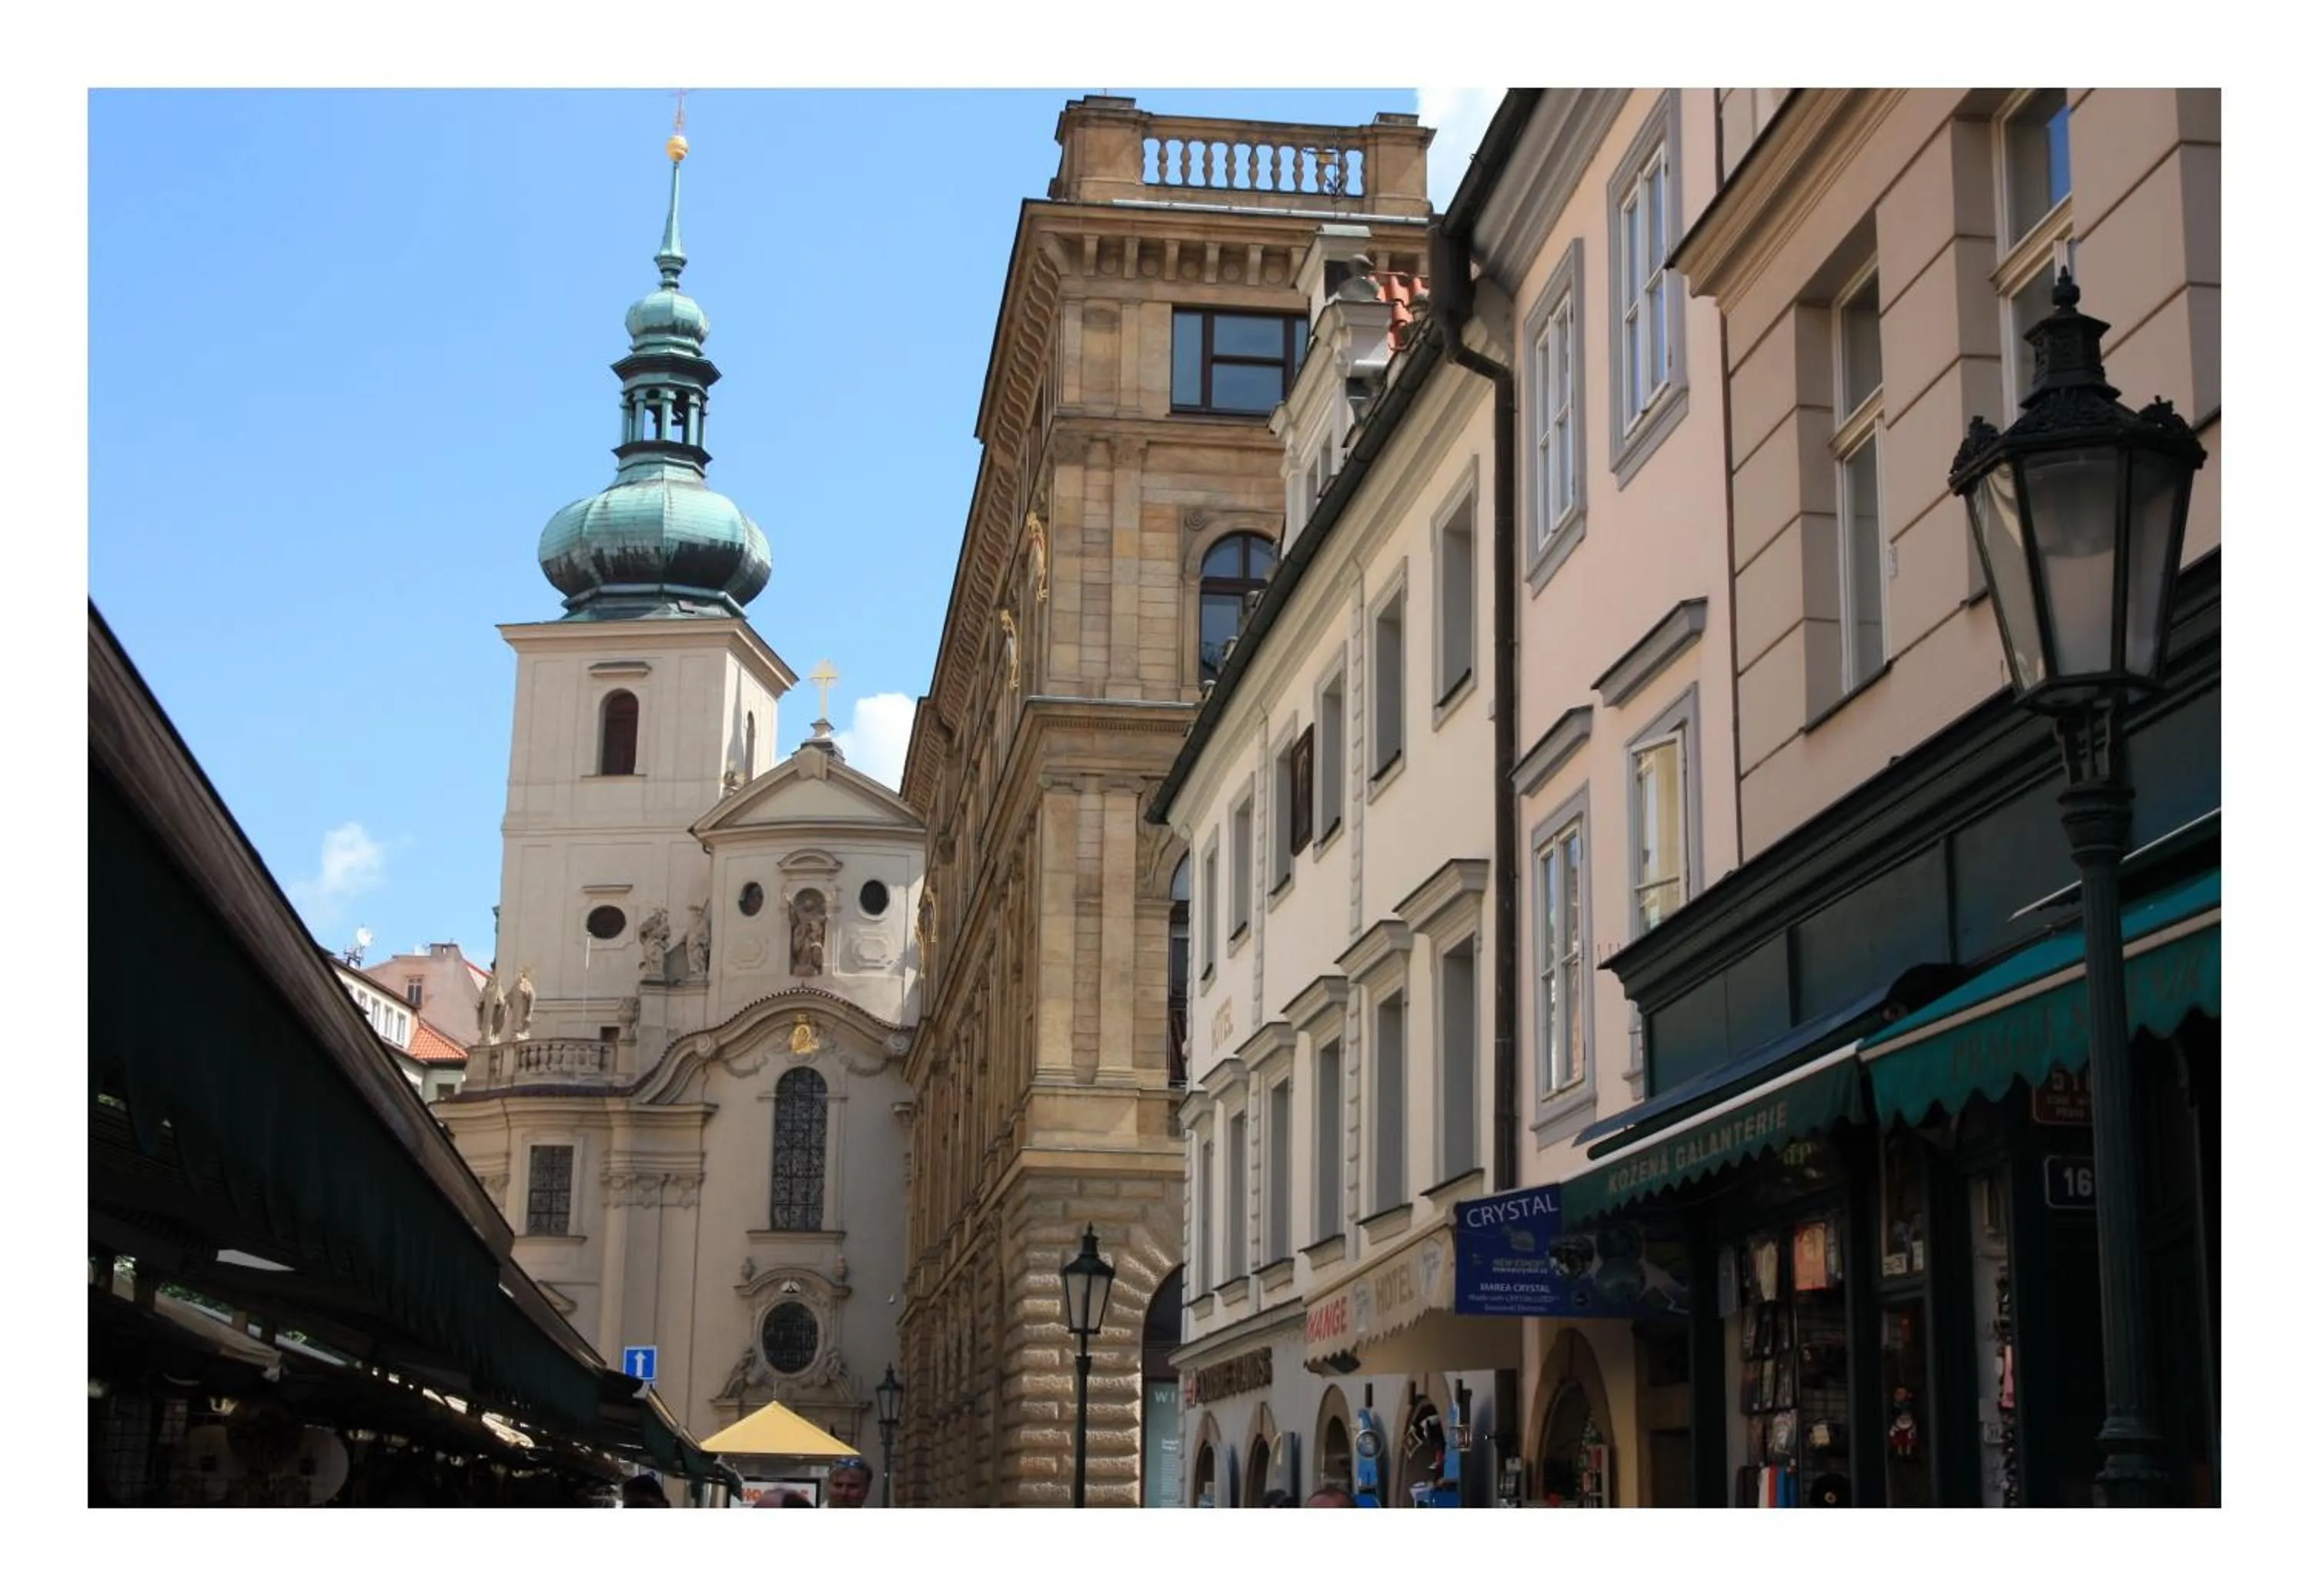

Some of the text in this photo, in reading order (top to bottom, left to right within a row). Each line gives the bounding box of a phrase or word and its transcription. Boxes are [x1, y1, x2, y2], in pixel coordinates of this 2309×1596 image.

[1676, 1101, 1788, 1171] GALANTERIE
[2063, 1166, 2093, 1197] 16
[1466, 1194, 1558, 1228] CRYSTAL
[1375, 1262, 1414, 1317] HOTEL
[1512, 1283, 1552, 1293] CRYSTAL
